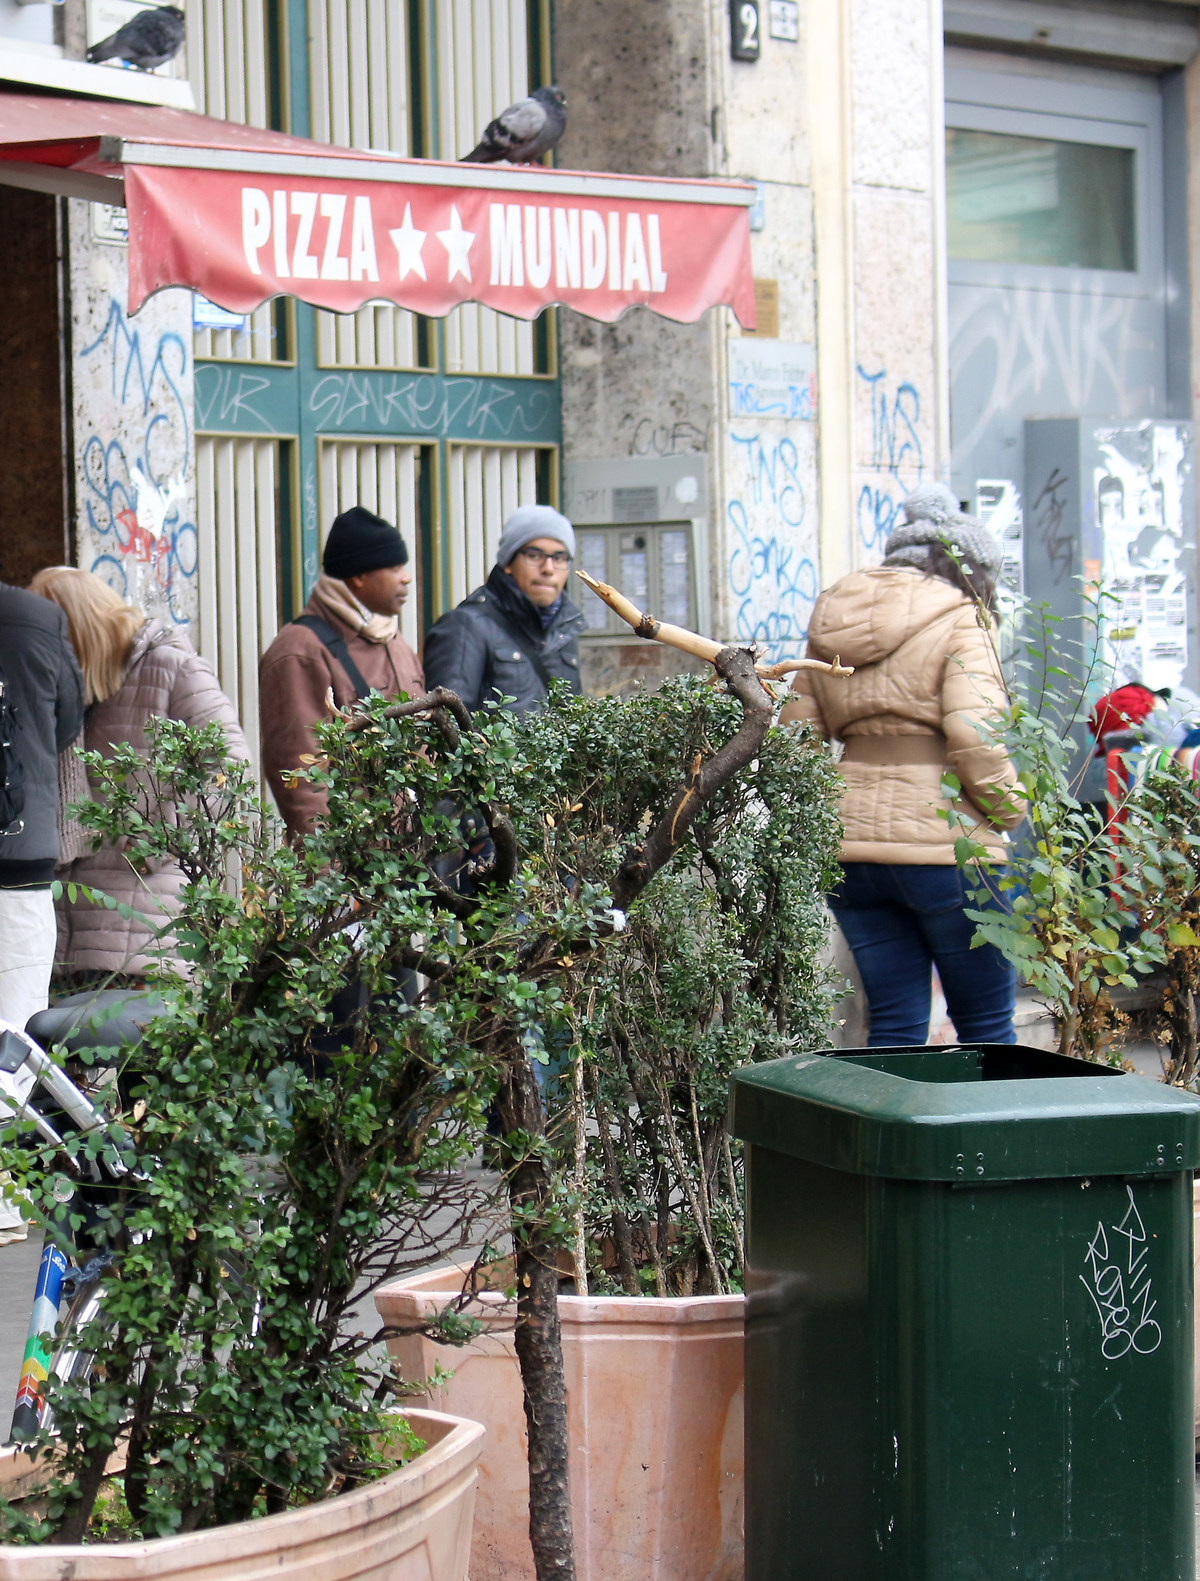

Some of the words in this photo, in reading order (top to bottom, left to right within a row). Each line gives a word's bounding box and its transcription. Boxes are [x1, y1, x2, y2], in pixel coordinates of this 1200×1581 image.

[741, 4, 759, 50] 2
[241, 187, 380, 283] PIZZA
[489, 203, 668, 293] MUNDIAL
